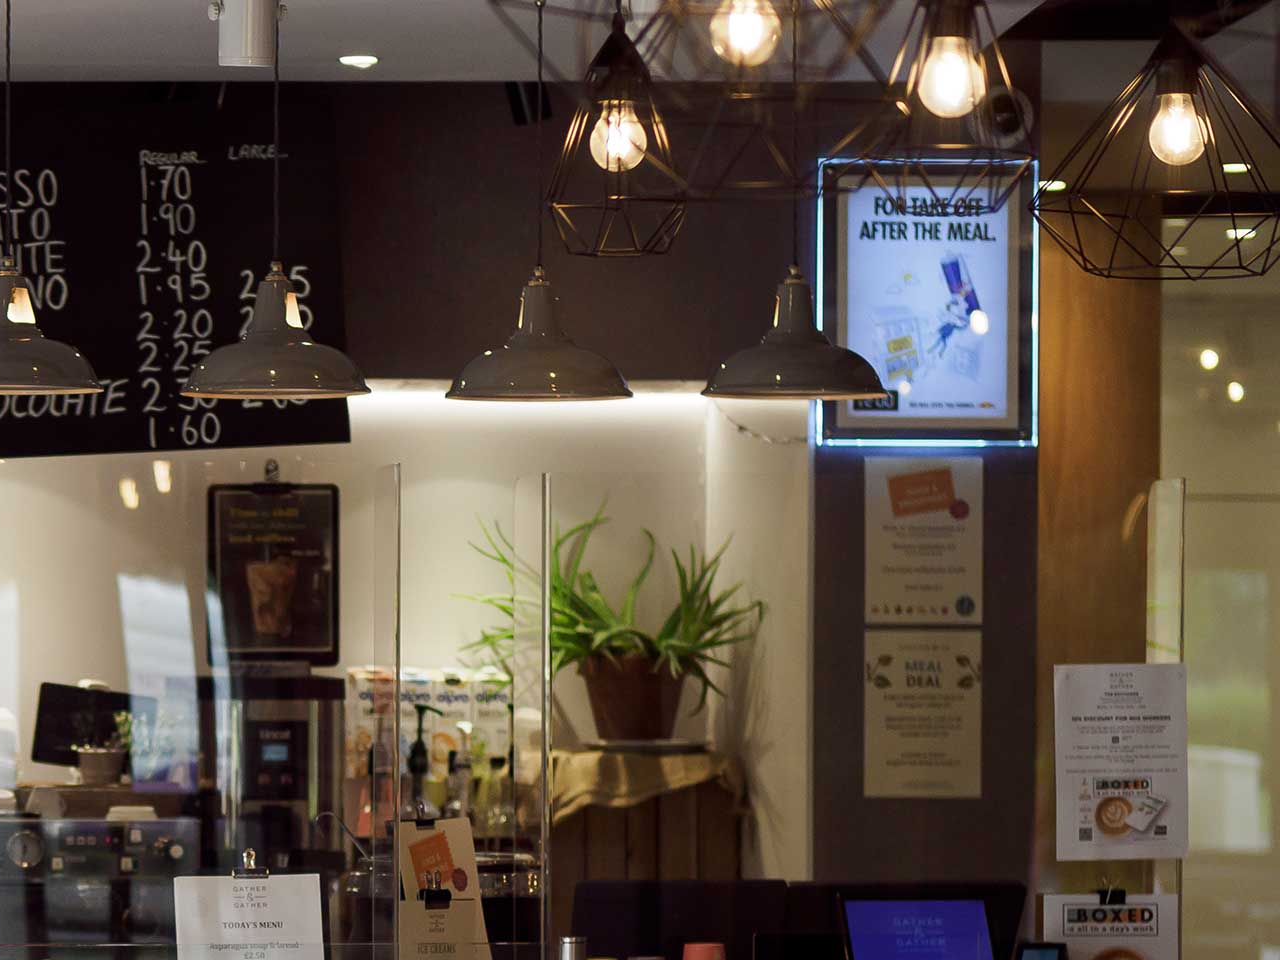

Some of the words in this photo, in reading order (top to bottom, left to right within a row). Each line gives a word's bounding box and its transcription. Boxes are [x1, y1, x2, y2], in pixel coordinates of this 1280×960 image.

[859, 221, 907, 240] AFTER
[913, 221, 942, 240] THE
[947, 222, 997, 241] MEAL.
[1076, 908, 1154, 923] BOXED
